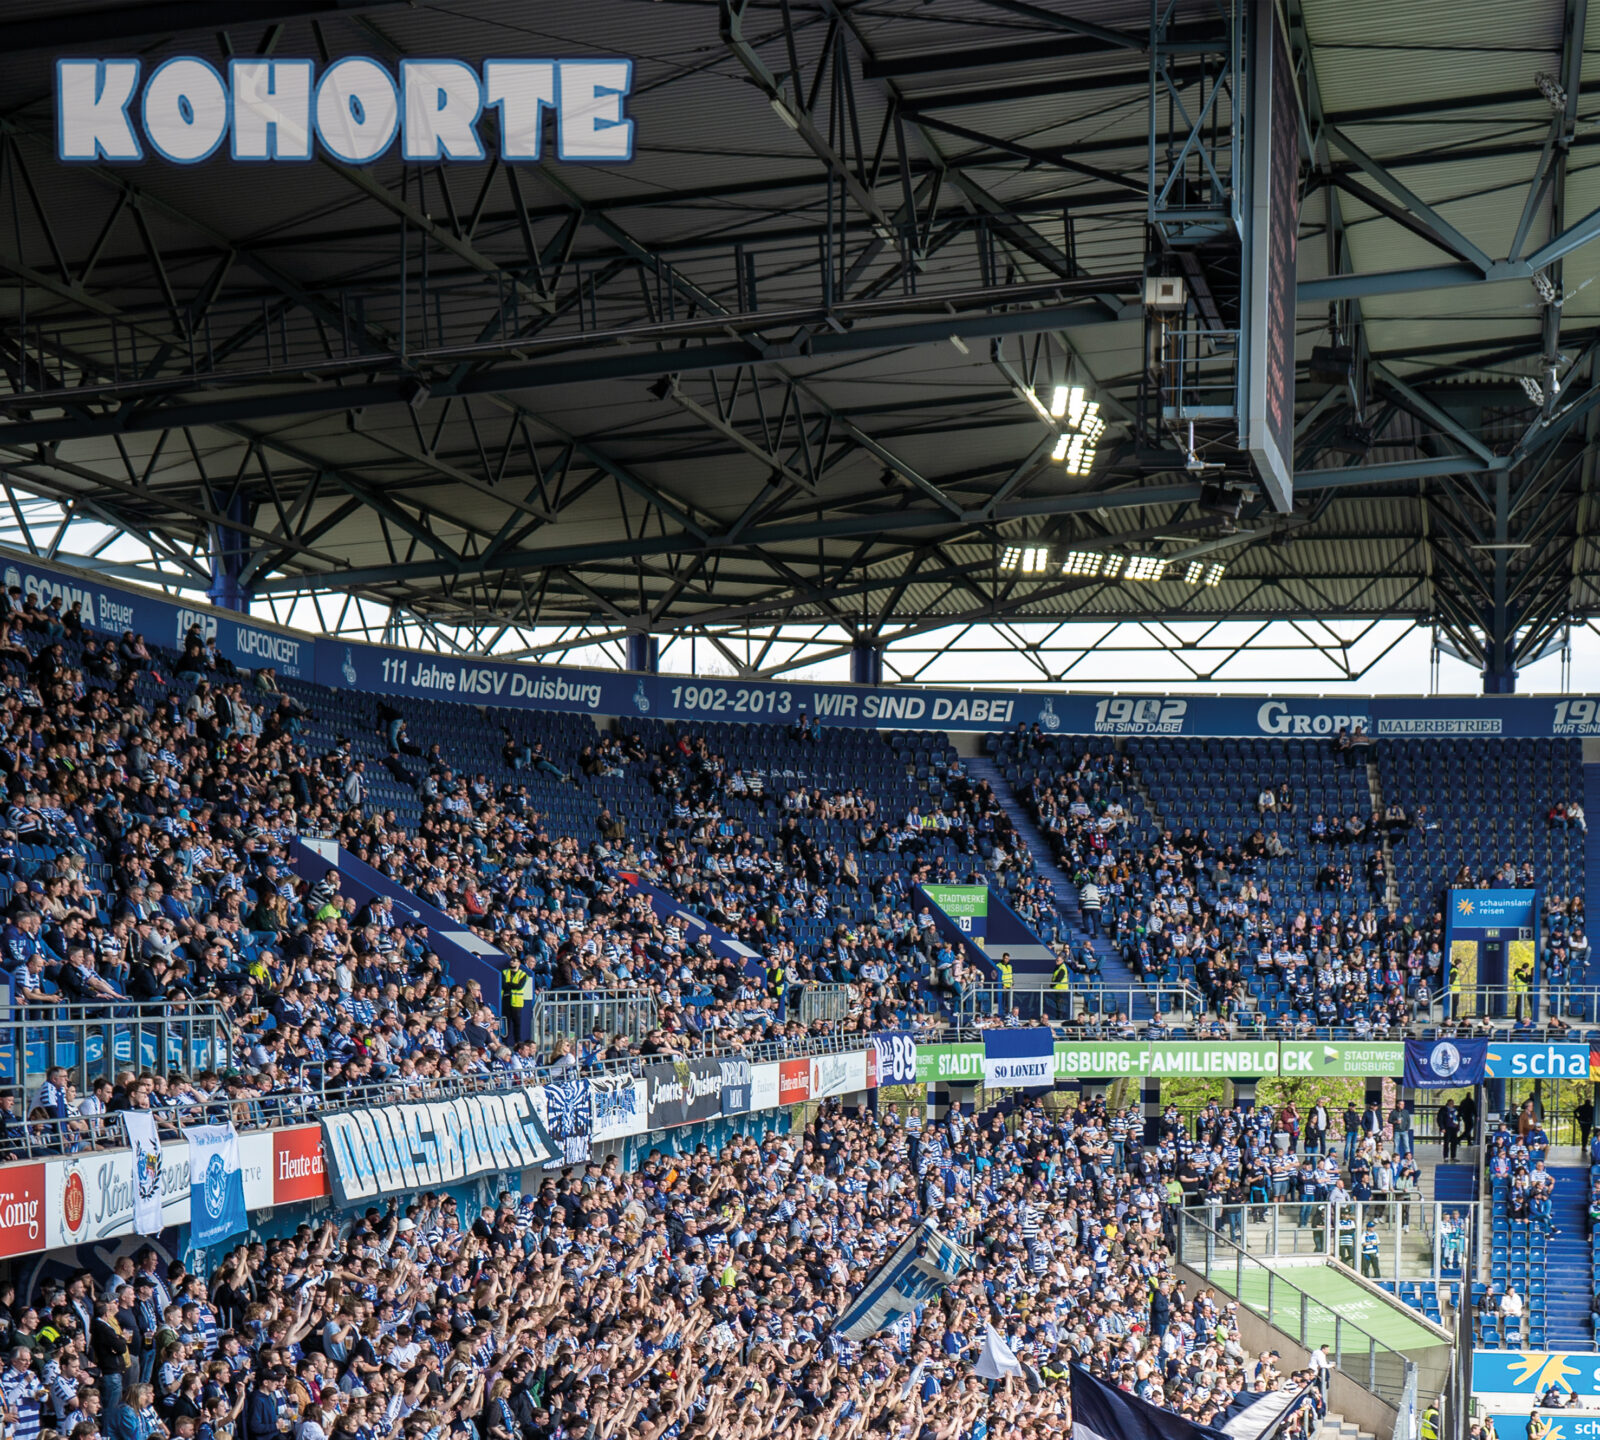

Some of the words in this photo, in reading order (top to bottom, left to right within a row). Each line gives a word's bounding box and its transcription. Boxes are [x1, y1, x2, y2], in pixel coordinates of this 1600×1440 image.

[99, 593, 133, 625] Breuer
[236, 627, 300, 665] KUPCONCEPT
[382, 657, 408, 685] 111
[411, 662, 456, 691] Jahre
[458, 667, 508, 695] MSV
[510, 673, 602, 708] Duisburg
[671, 685, 793, 714] 1902-2013
[813, 692, 859, 718] WIR
[862, 695, 926, 719] SIND
[931, 698, 1015, 723] DABEI
[1095, 699, 1188, 722] 1902
[1553, 700, 1600, 724] 19
[1094, 721, 1115, 733] WIR
[1115, 722, 1144, 733] SIND
[1146, 722, 1183, 734] DABEI
[1379, 719, 1501, 733] MALERBETRIEB
[1552, 723, 1575, 734] WIR
[938, 893, 986, 904] STADTWERKE
[1480, 899, 1532, 907] schauinsland
[1480, 907, 1505, 915] reisen
[960, 919, 970, 929] 12
[1520, 929, 1532, 939] 13
[892, 1034, 917, 1081] 89
[1344, 1051, 1405, 1061] STADTWERK
[1419, 1057, 1428, 1065] 19
[938, 1052, 986, 1075] STADT
[994, 1065, 1008, 1079] SO
[1010, 1062, 1048, 1078] LONELY
[1344, 1062, 1396, 1072] DUISBURG
[279, 1150, 311, 1181] Heute
